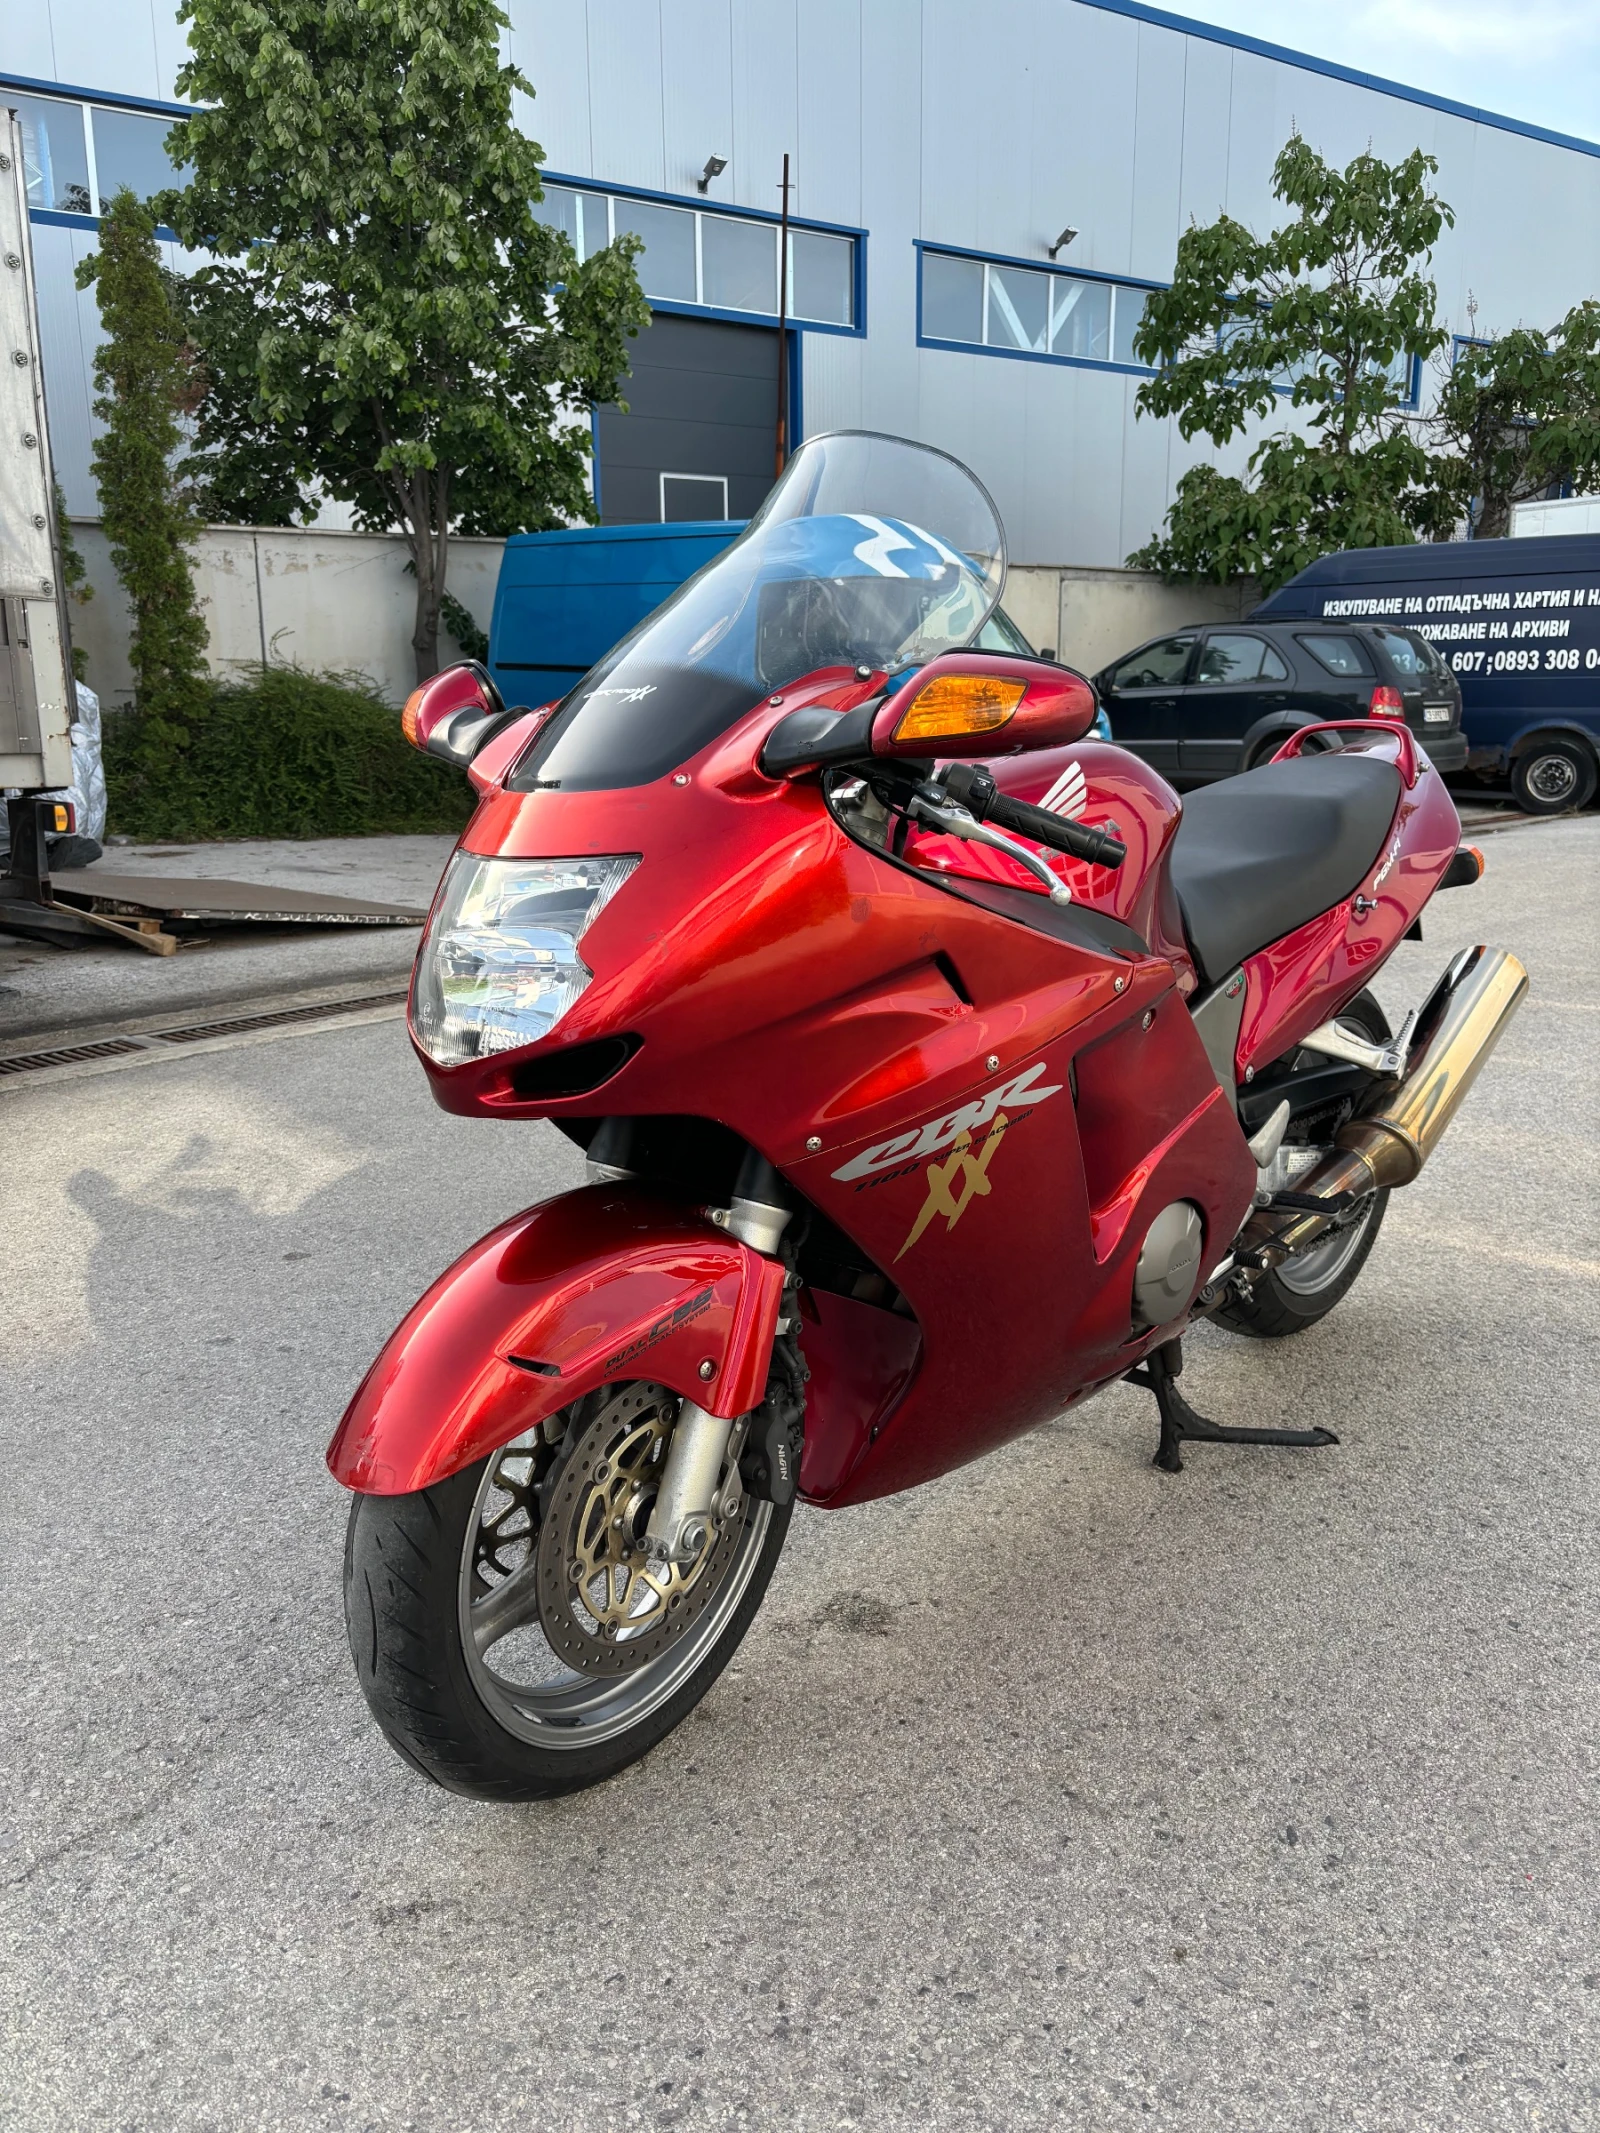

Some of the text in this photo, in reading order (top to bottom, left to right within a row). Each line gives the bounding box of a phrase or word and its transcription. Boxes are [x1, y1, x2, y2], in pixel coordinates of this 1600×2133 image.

[1323, 588, 1600, 617] ИЗКУПУВАНЕ НА ОТПАДЪЧНА ХАРТИЯ И Н
[1489, 621, 1509, 639] НА
[1511, 620, 1571, 638] АРХИВИ
[1544, 649, 1580, 670] 308
[1585, 648, 1600, 670] 0
[830, 1061, 1064, 1182] CBR
[933, 1108, 1034, 1163] SUPER BLACKBIRD
[854, 1161, 921, 1193] 1100
[893, 1112, 1009, 1265] XX
[605, 1284, 714, 1370] DUAL CBS
[678, 1302, 711, 1329] SYSTEM
